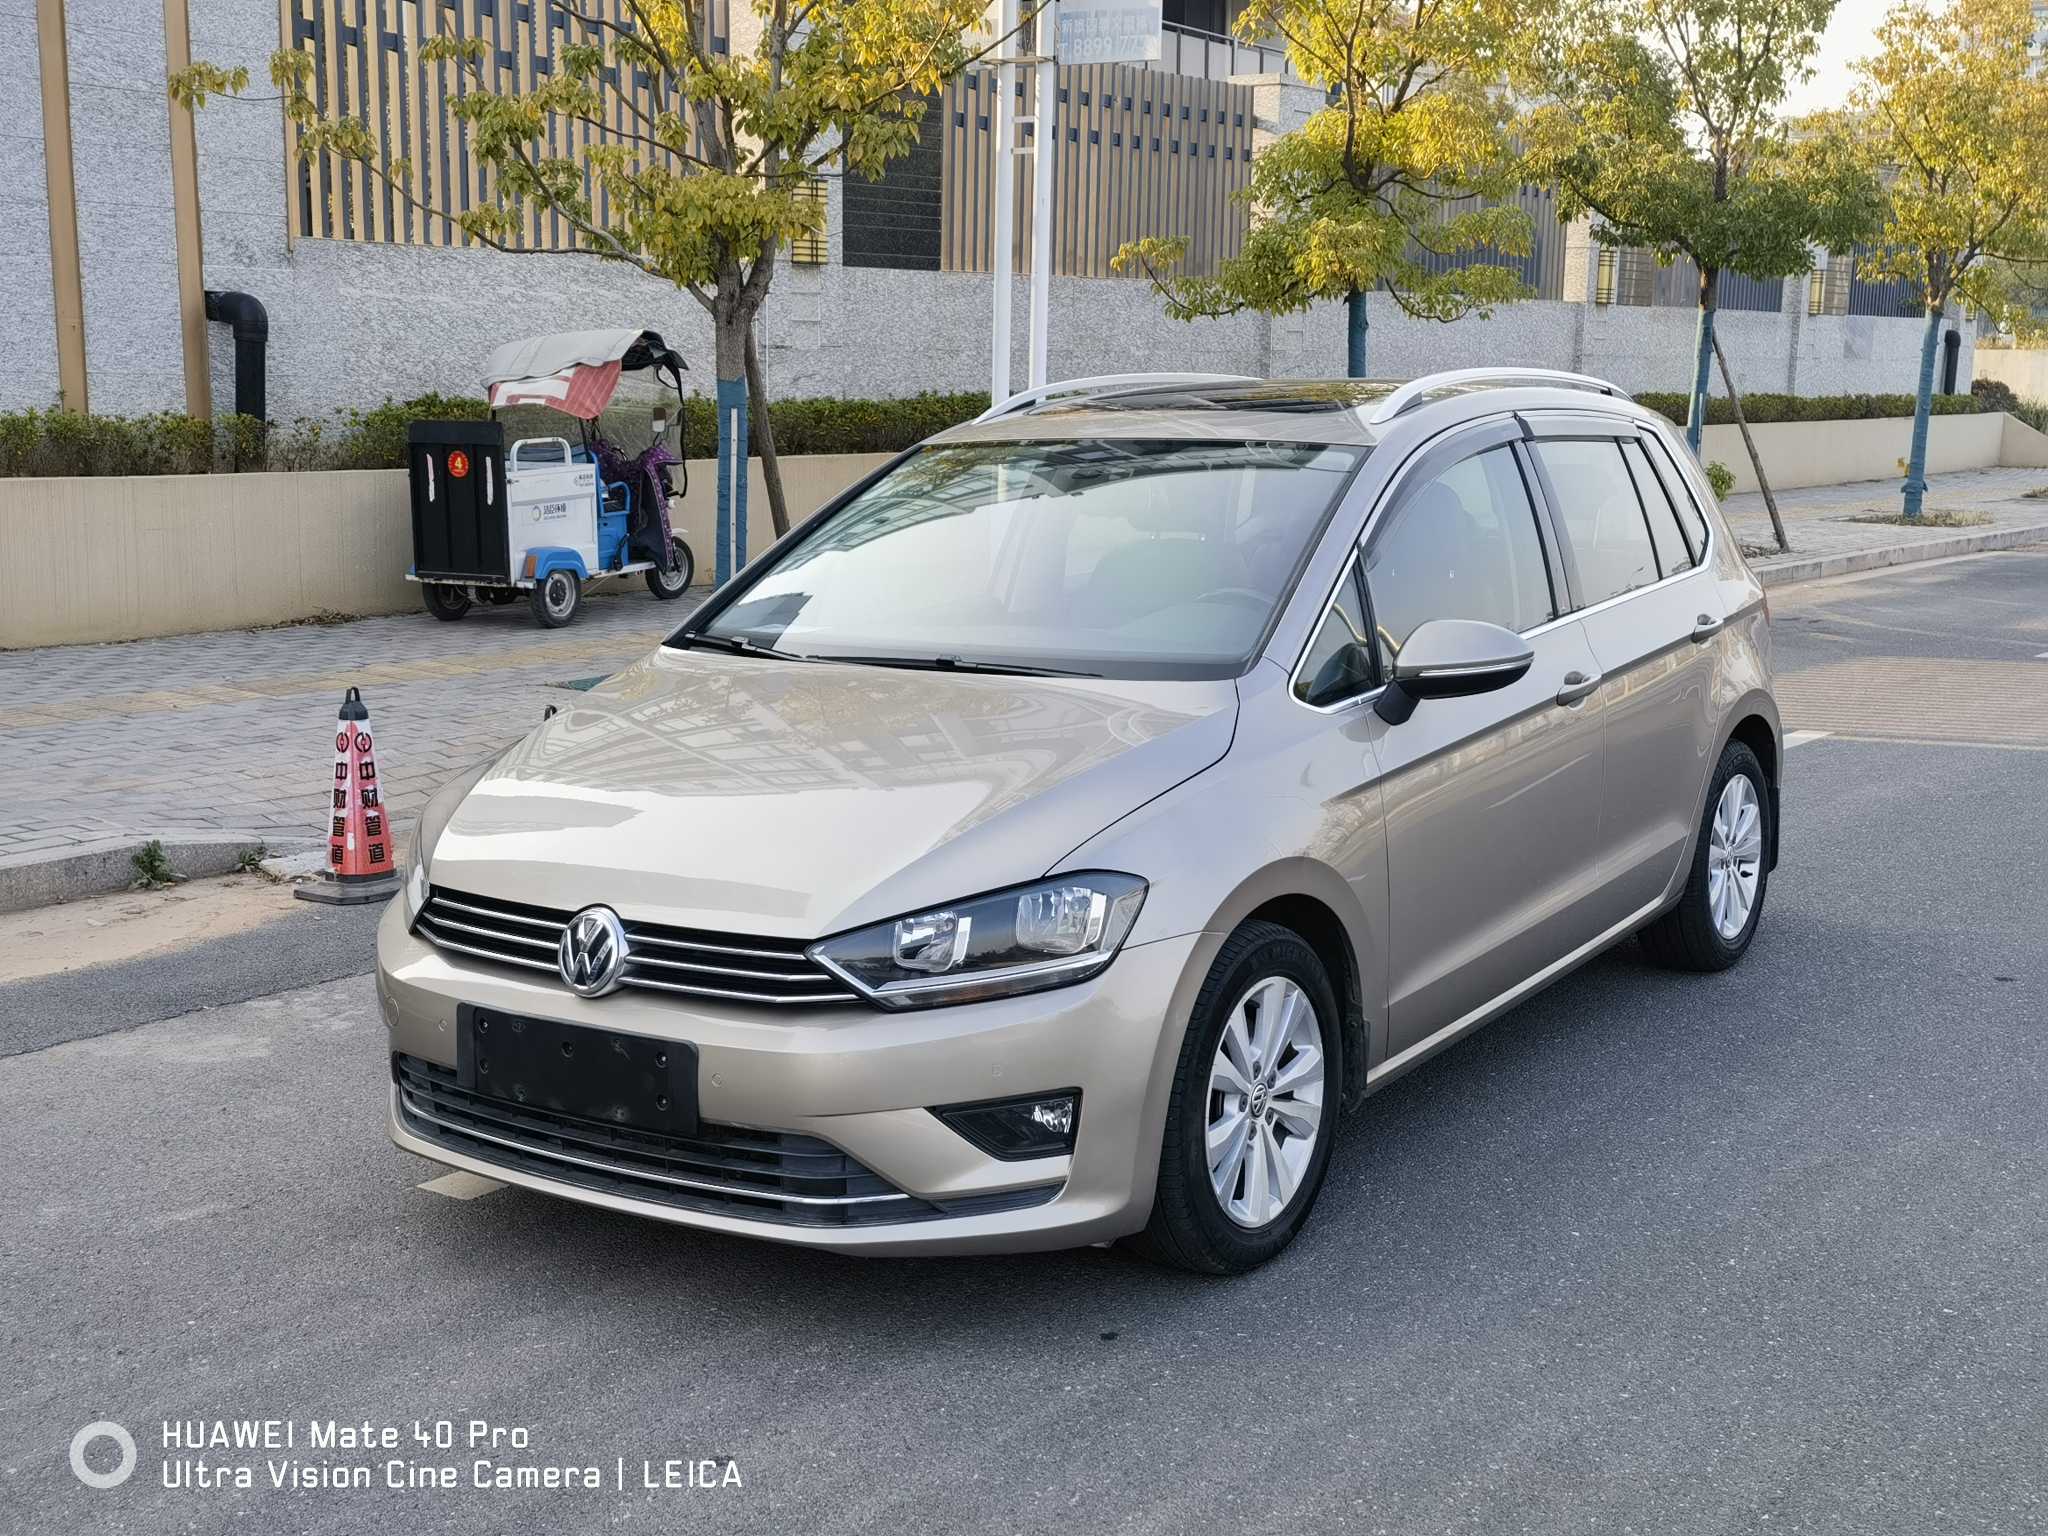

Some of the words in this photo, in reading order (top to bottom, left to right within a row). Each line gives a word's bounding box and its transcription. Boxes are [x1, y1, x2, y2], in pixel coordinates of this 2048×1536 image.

[454, 456, 463, 470] 4
[359, 761, 386, 865] 中财管道
